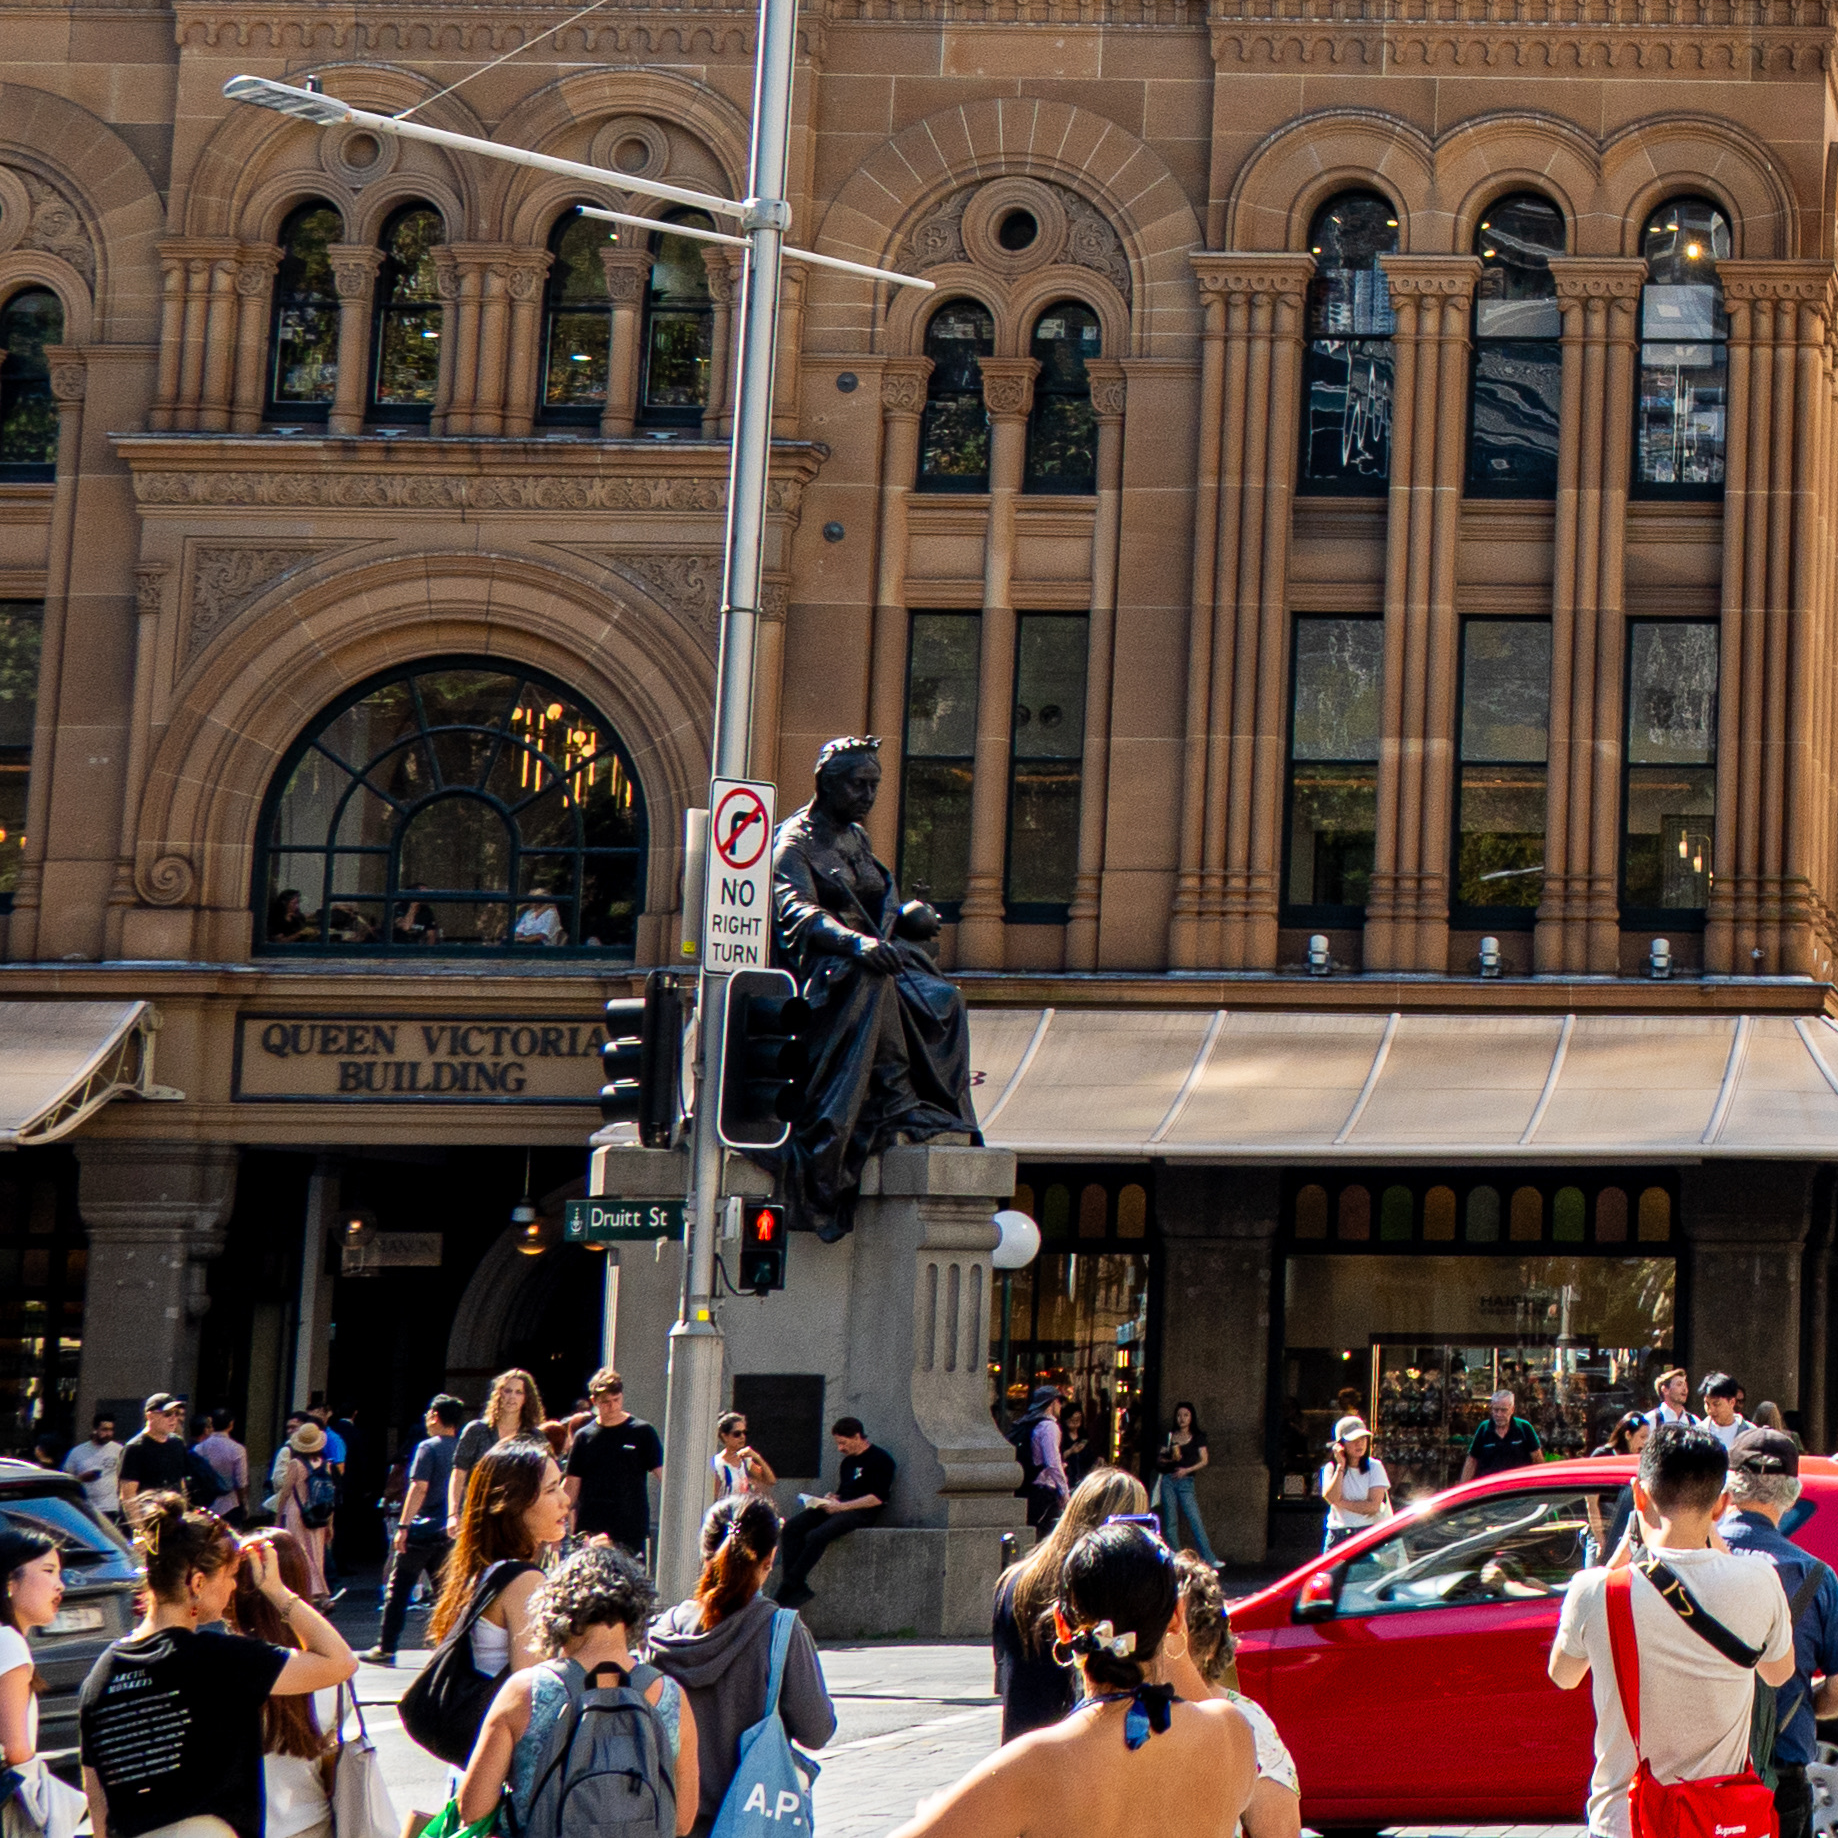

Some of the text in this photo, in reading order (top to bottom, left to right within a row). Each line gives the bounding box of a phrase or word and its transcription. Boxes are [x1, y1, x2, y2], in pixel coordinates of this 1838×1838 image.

[720, 877, 755, 907] NO
[712, 914, 762, 936] RIGHT
[712, 942, 758, 964] TURN
[261, 1023, 606, 1057] QUEEN VICTORIA
[337, 1061, 528, 1093] BUILDING
[591, 1207, 668, 1226] Druitt St
[743, 1782, 802, 1826] A.P.
[1715, 1823, 1747, 1838] Supreme
